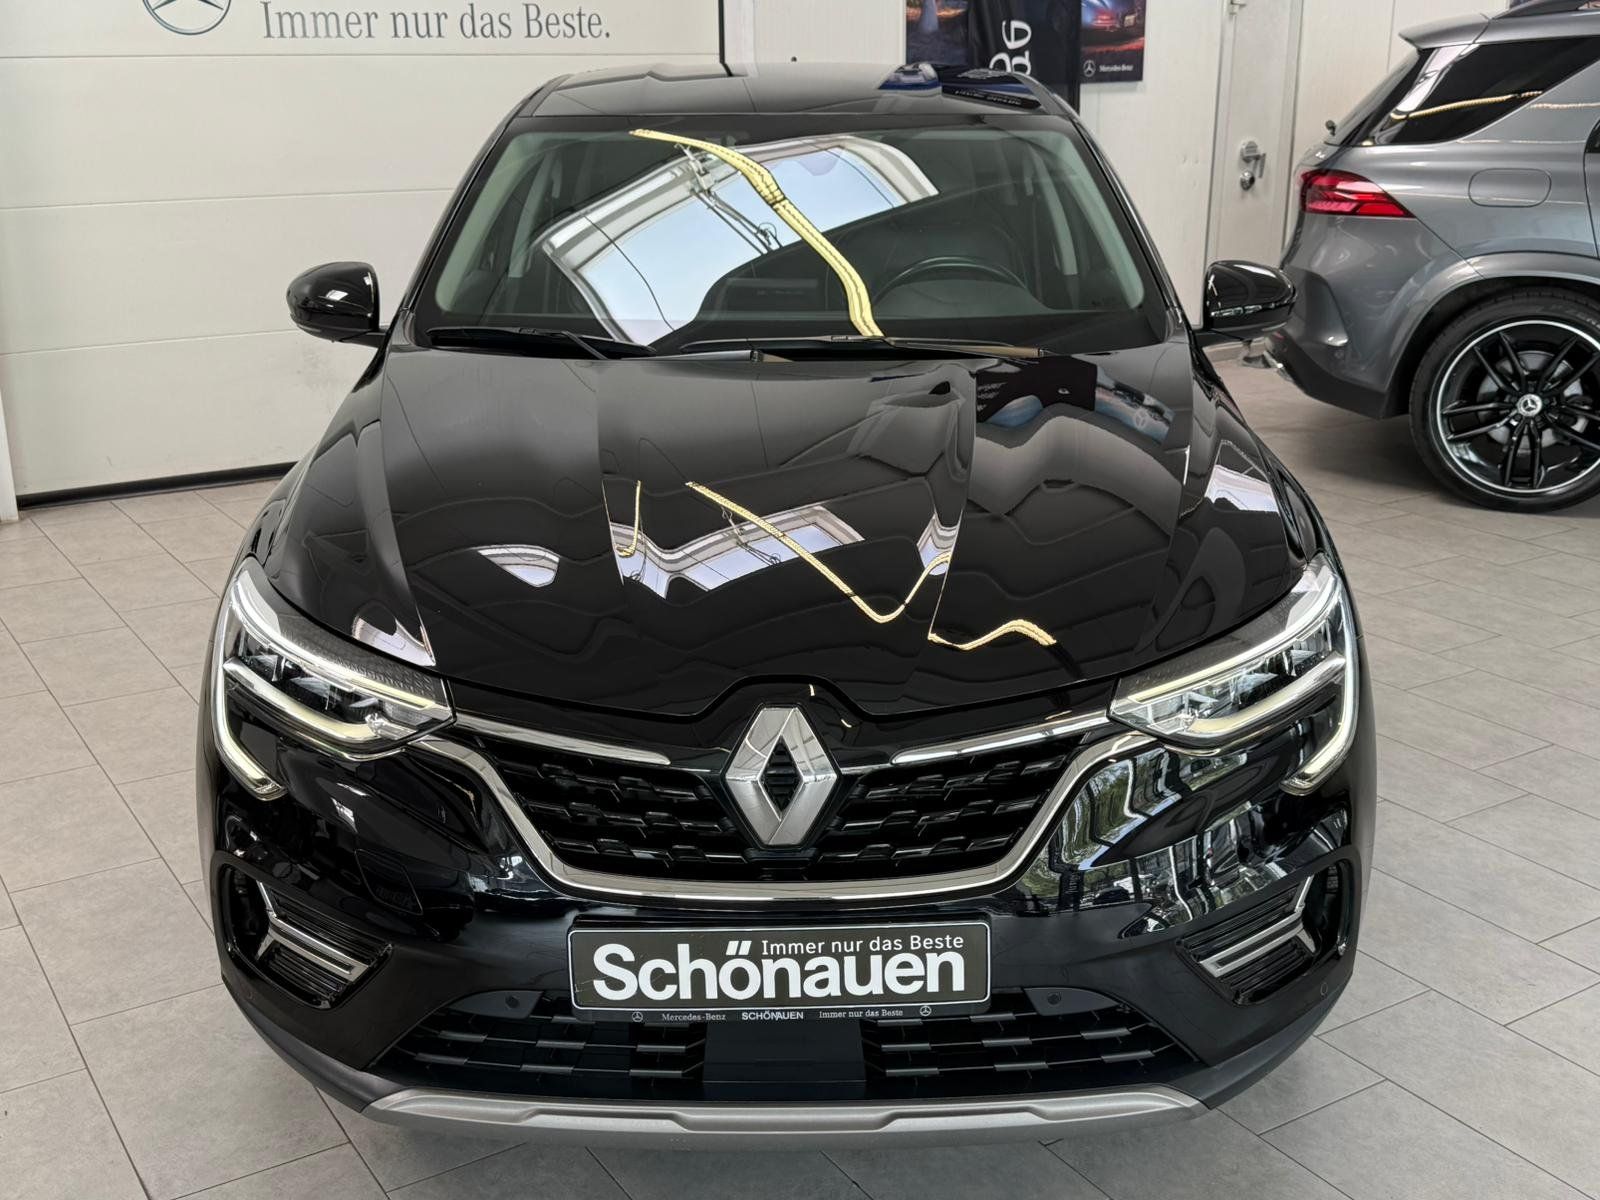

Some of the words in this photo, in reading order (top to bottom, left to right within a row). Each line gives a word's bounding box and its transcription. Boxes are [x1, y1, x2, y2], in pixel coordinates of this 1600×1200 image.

[260, 1, 378, 39] Immer
[390, 10, 448, 39] nur
[459, 2, 512, 39] das
[522, 2, 611, 39] Beste.
[762, 939, 825, 955] Immer
[831, 940, 863, 953] nur
[869, 936, 903, 951] das
[910, 934, 964, 950] Beste
[593, 940, 966, 1001] Schönauen
[661, 1012, 726, 1022] Mercedes-Benz
[741, 1010, 804, 1021] SCHÖNAUEN
[819, 1010, 847, 1019] Immer
[848, 1010, 863, 1018] nur
[865, 1009, 880, 1017] das
[881, 1008, 904, 1017] Beste
